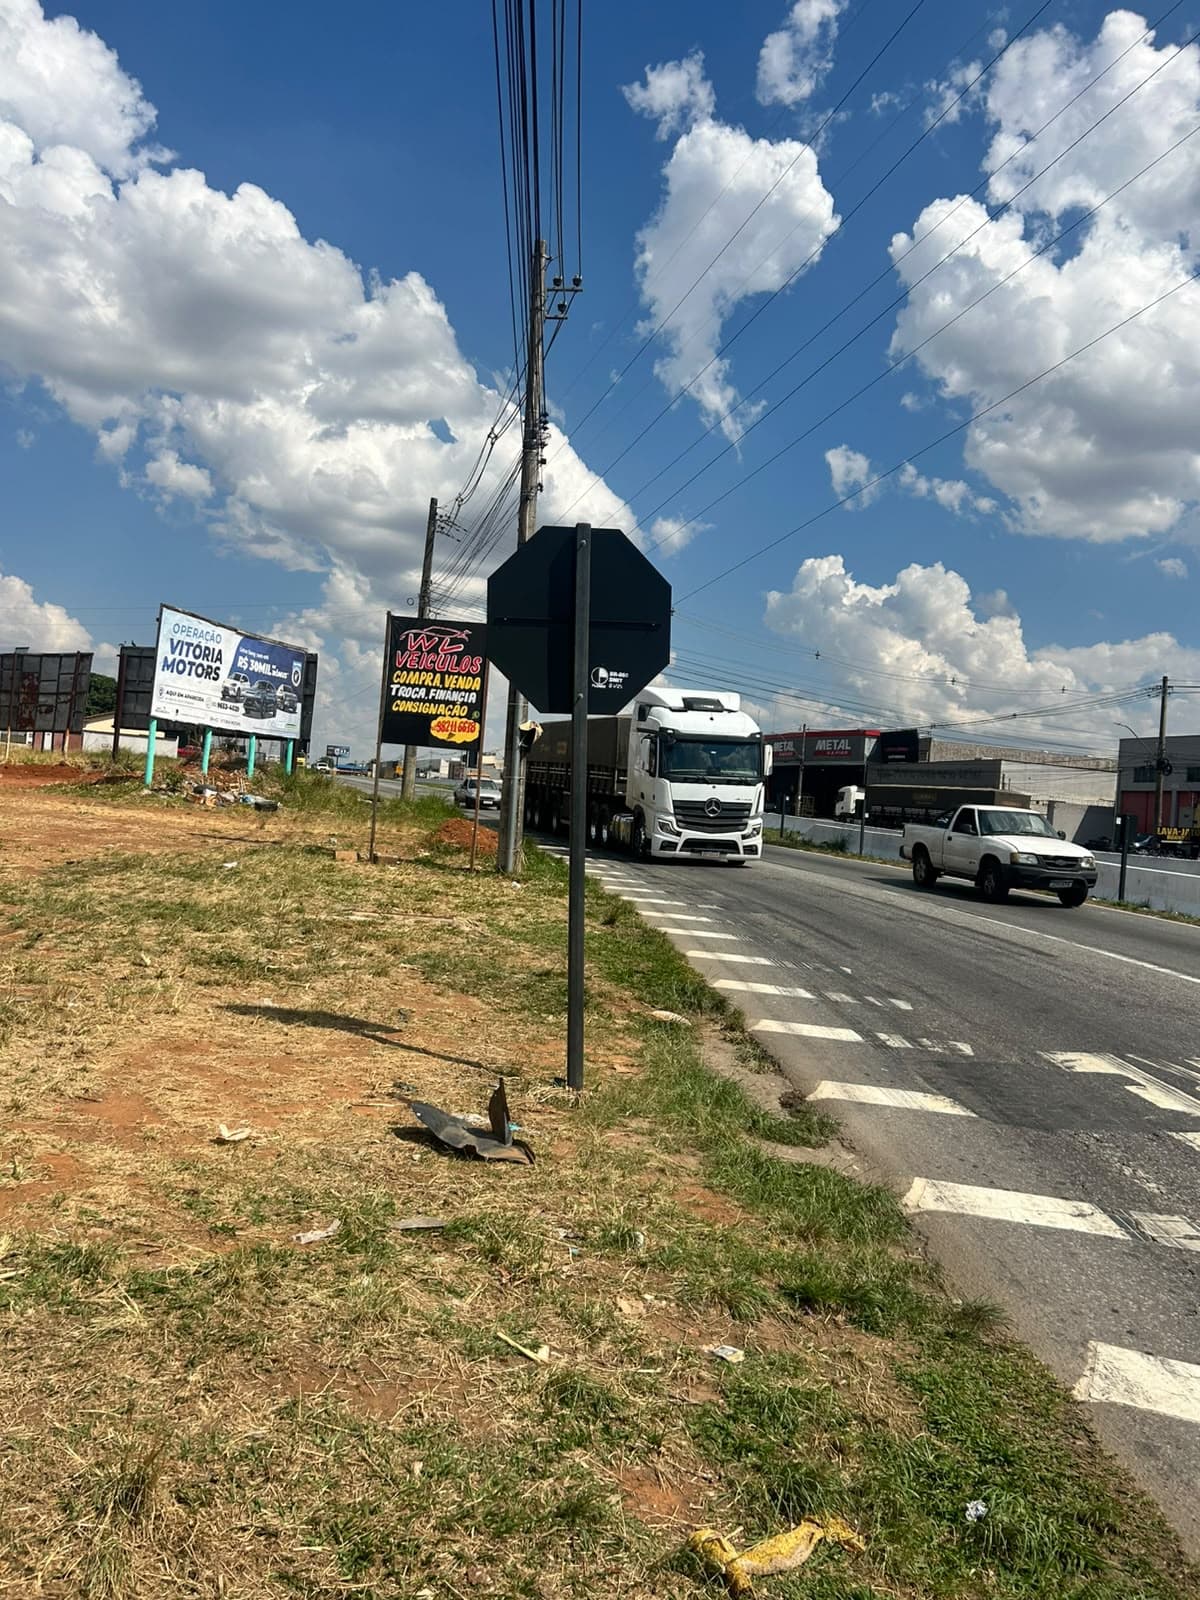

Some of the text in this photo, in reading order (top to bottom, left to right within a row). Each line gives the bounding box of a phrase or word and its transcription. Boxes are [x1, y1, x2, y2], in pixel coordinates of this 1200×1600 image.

[173, 623, 222, 645] OPERAÇÃO
[170, 638, 223, 664] VITÓRIA
[161, 656, 220, 681] MOTORS
[444, 674, 481, 691] VENDA
[392, 700, 468, 717] CONSIGNAÇÃO
[774, 741, 794, 752] METAL
[815, 739, 852, 751] METAL
